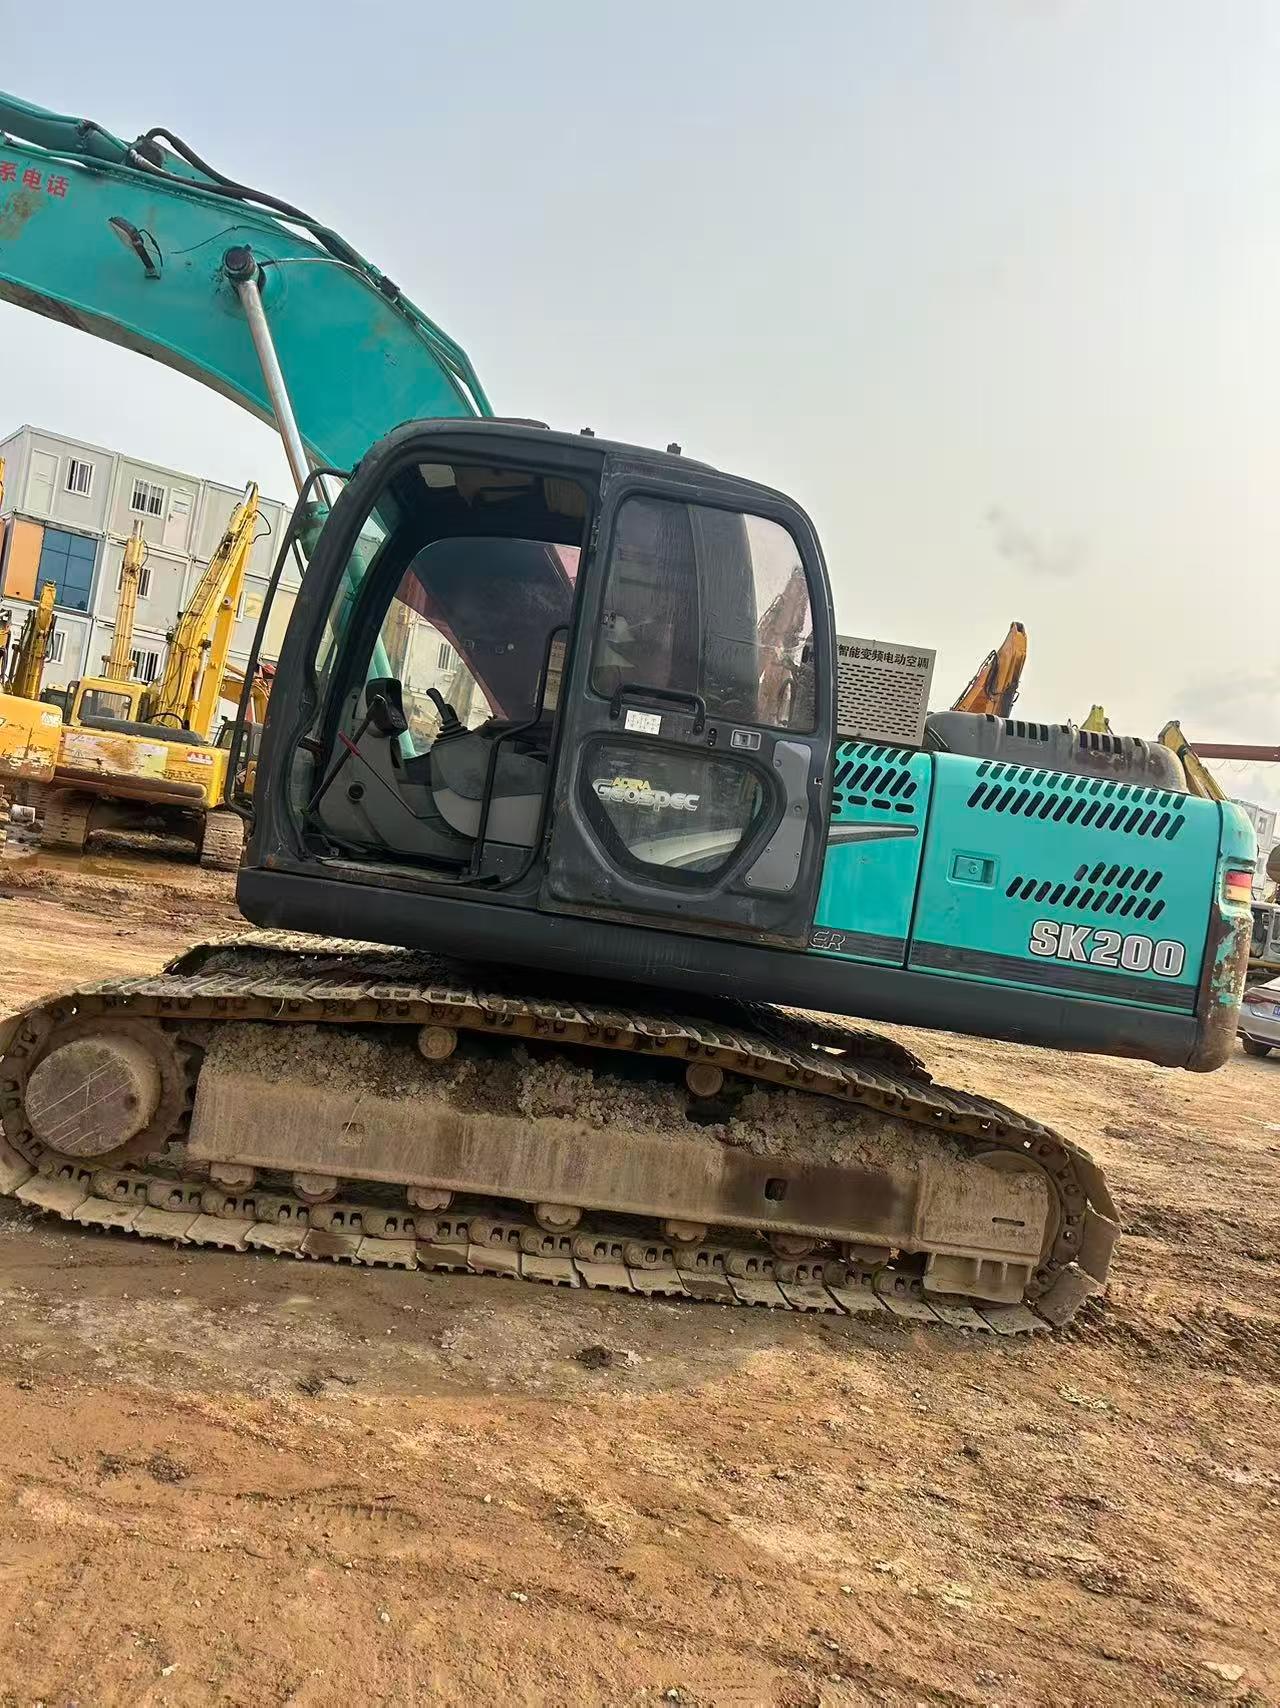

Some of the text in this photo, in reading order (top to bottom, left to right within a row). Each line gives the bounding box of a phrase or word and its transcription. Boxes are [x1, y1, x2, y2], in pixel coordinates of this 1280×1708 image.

[838, 643, 930, 670] 智能变频电动空调
[1029, 919, 1186, 977] SK200
